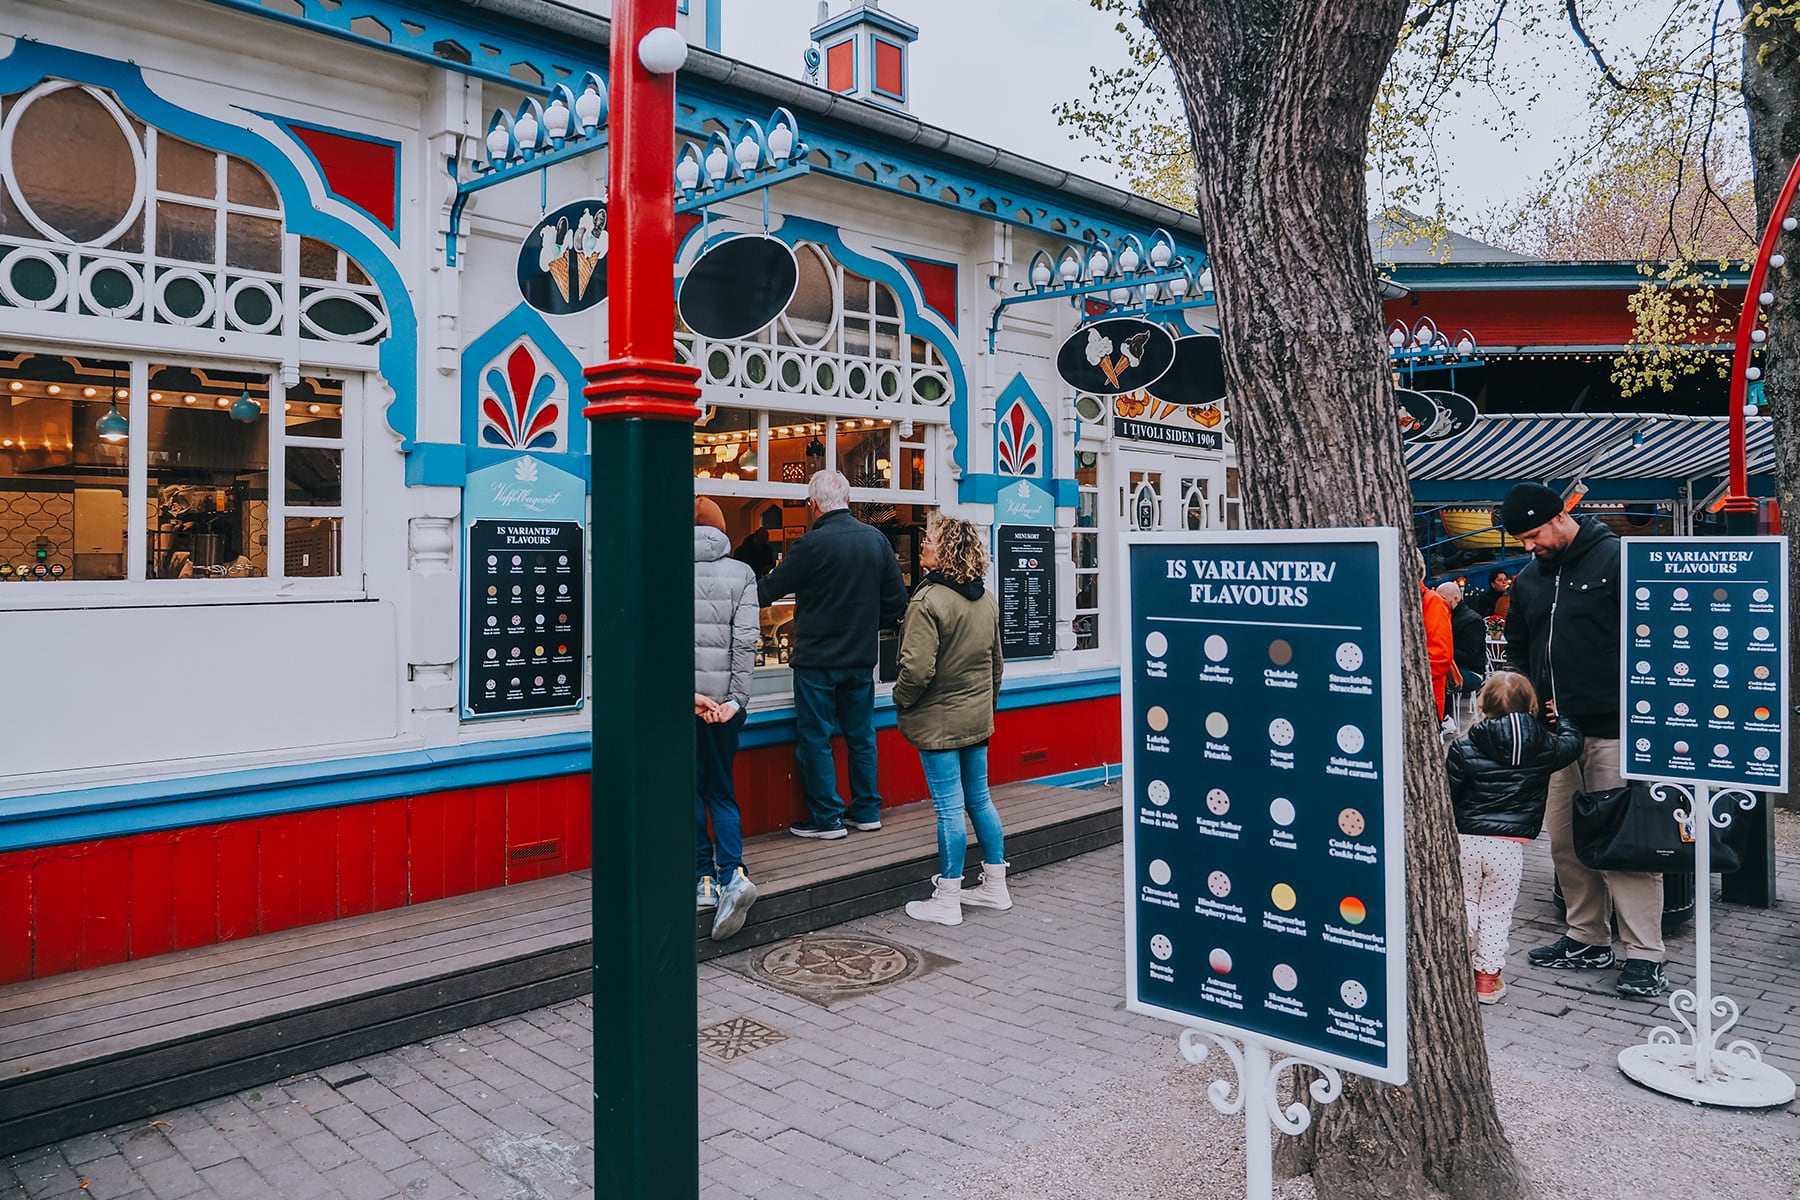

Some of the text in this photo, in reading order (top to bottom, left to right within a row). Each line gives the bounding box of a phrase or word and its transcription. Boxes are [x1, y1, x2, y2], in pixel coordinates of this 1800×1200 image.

[1123, 422, 1215, 446] I TIVOLI SIDEN 1906
[497, 526, 560, 536] IS VARIANTER/
[506, 536, 551, 544] FLAVOURS
[1648, 551, 1754, 562] IS VARIANTER/
[1166, 559, 1337, 583] IS VARIANTER/
[1664, 563, 1738, 574] FLAVOURS
[1189, 583, 1309, 607] FLAVOURS
